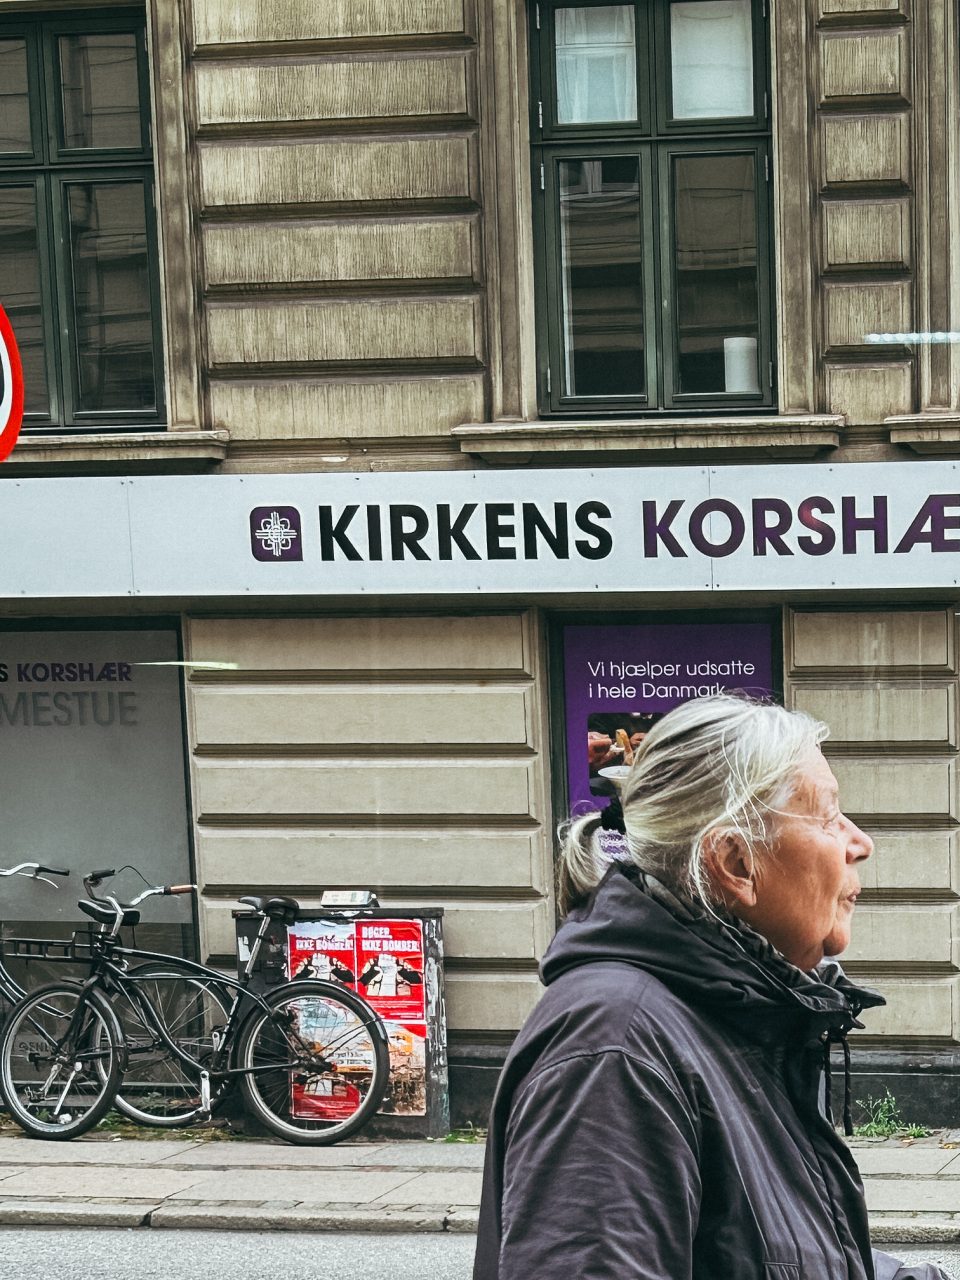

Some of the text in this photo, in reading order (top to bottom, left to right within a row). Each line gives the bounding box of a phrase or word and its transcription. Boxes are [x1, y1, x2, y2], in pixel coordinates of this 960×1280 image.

[319, 501, 612, 561] KIRKENS
[17, 662, 132, 682] KORSHÆR
[588, 660, 755, 680] Vi hjælper udsatte
[589, 682, 725, 699] i hele Danmark
[361, 940, 382, 951] IKKE
